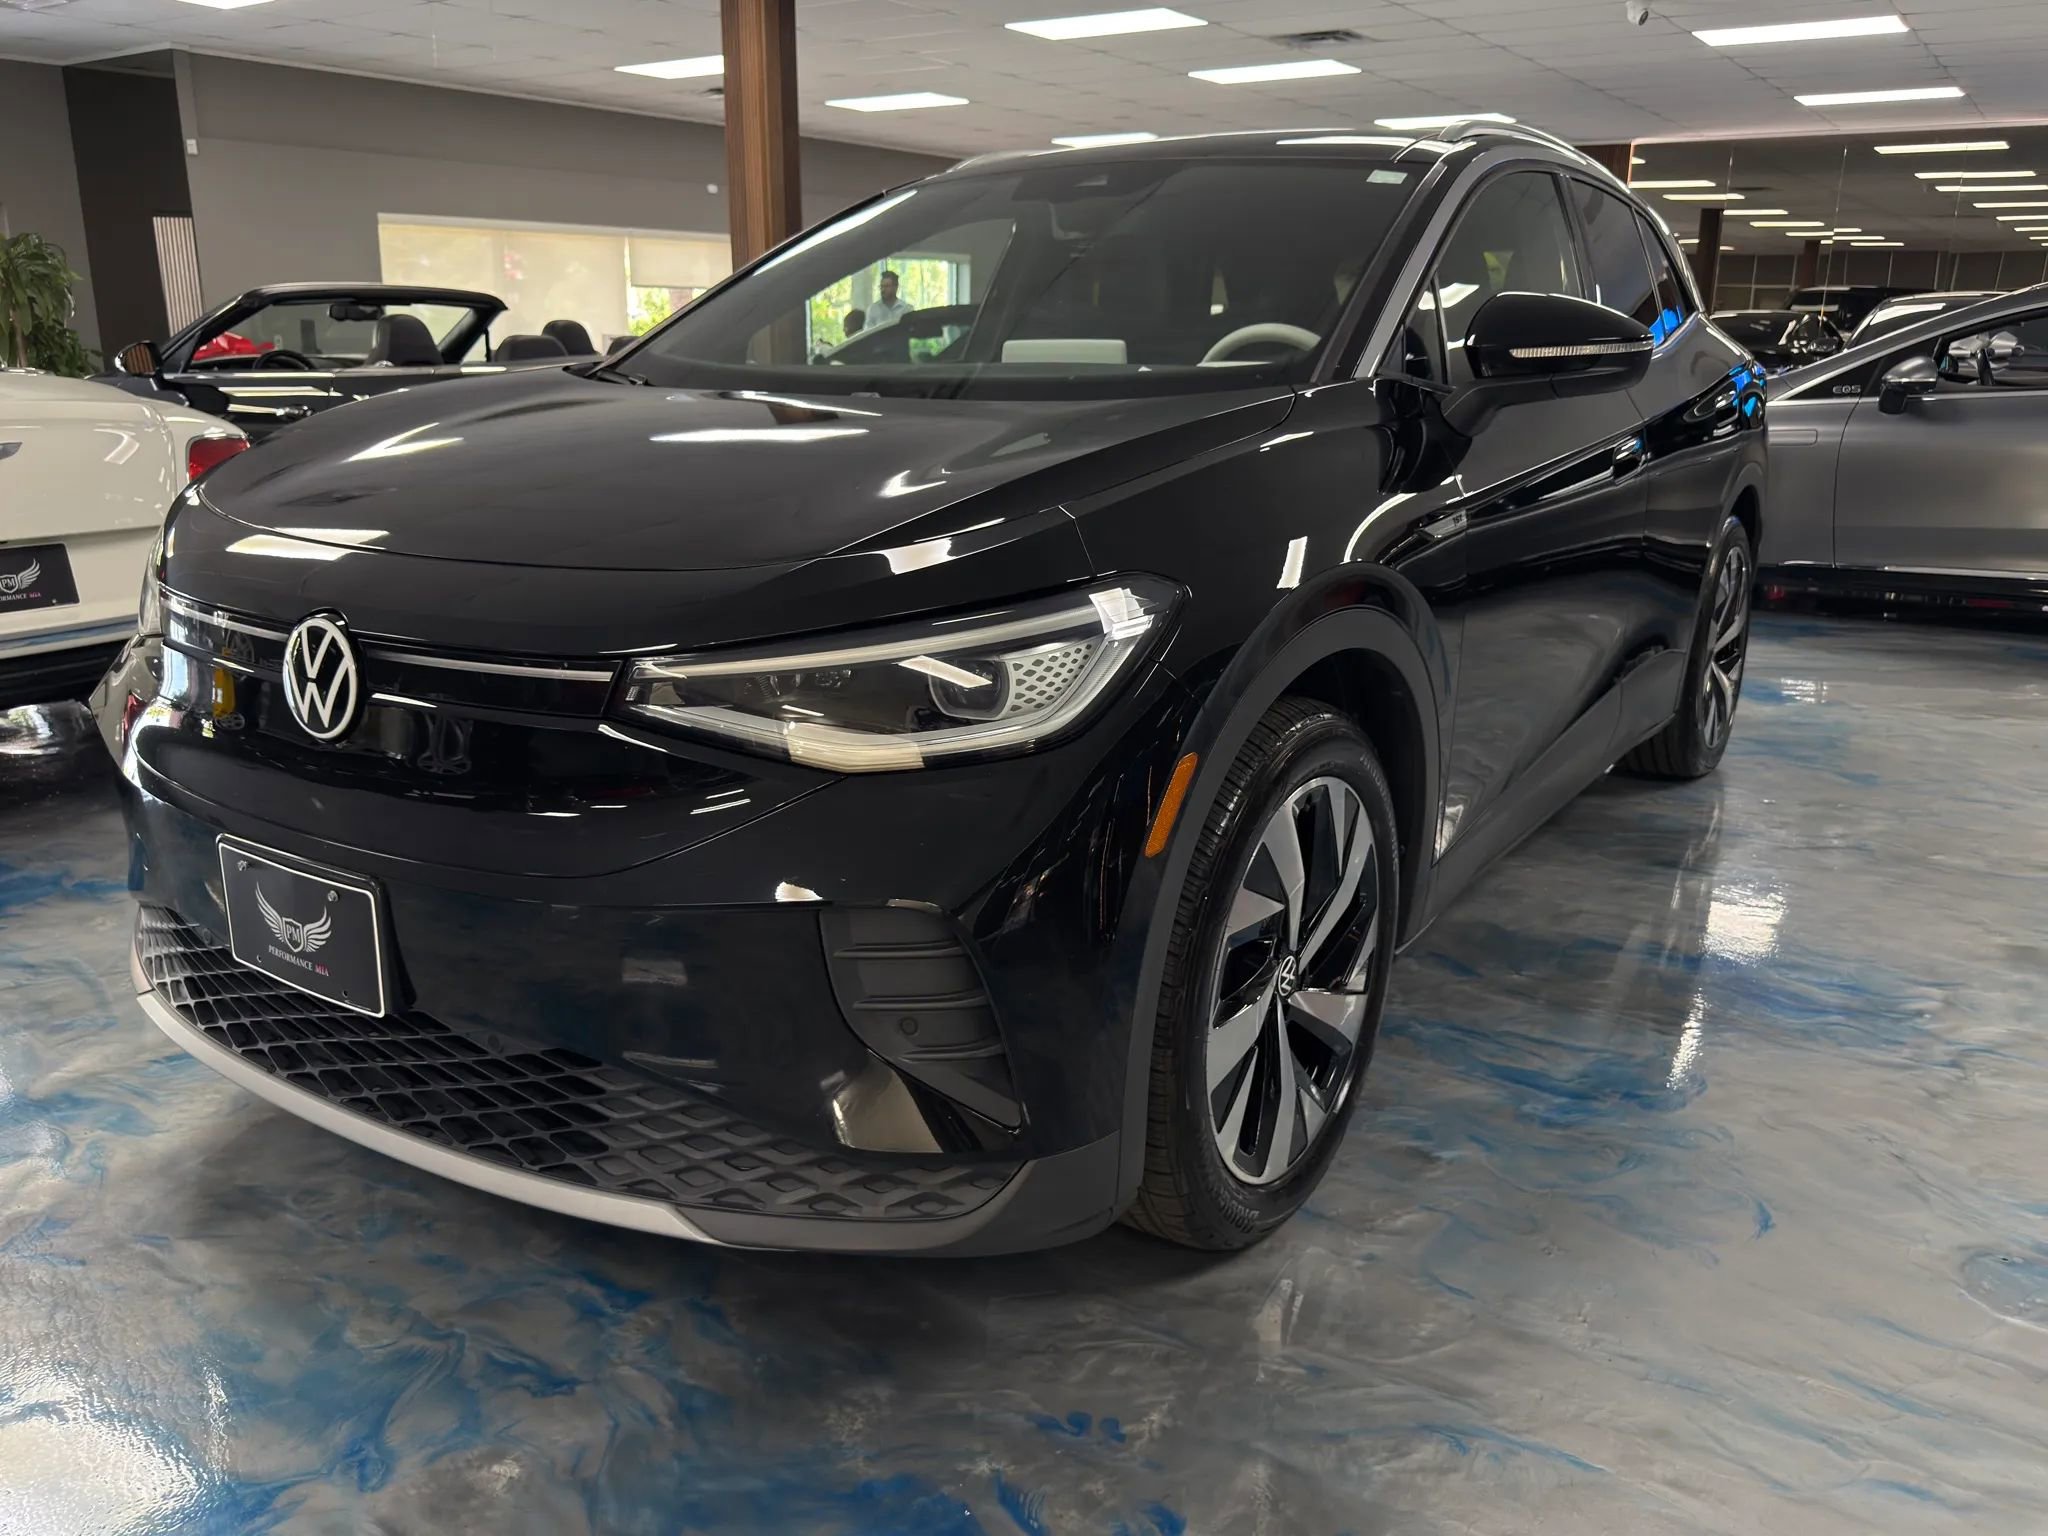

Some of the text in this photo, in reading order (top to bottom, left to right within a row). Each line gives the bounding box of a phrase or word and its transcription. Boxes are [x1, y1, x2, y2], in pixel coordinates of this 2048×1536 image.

[1832, 385, 1861, 394] EQS
[2, 577, 15, 588] PM
[286, 924, 301, 943] PM
[268, 944, 313, 971] PERFORMANCE
